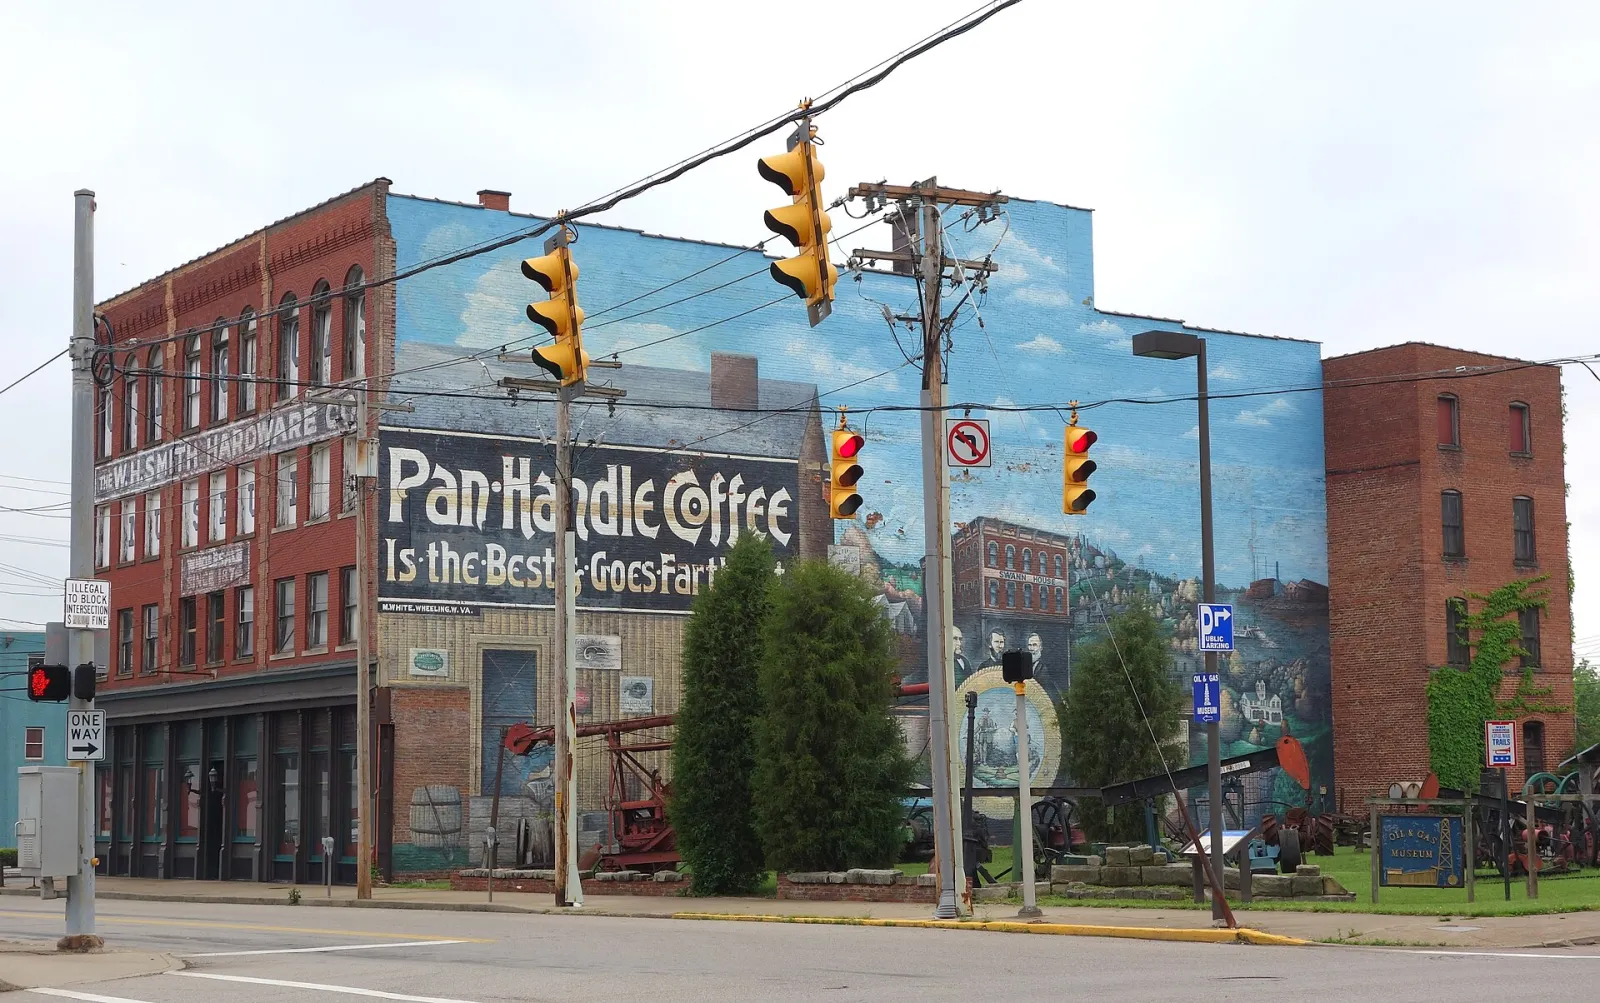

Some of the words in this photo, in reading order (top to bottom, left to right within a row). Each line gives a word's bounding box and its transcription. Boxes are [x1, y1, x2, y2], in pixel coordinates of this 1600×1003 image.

[206, 405, 317, 467] HARDWARE
[663, 468, 793, 547] Coffee
[999, 571, 1027, 581] SWANN
[1033, 576, 1056, 586] HOUSE
[71, 583, 104, 594] ILLEGAL
[68, 594, 77, 603] TO
[81, 594, 107, 604] BLOCK
[67, 604, 108, 615] INTERSECTION
[92, 615, 107, 626] FINE
[1209, 674, 1219, 682] GAS
[1197, 706, 1217, 715] MUSEUM
[72, 714, 100, 726] ONE
[71, 728, 101, 740] WAY
[1389, 829, 1405, 841] OIL
[1407, 828, 1414, 837] &
[1416, 830, 1438, 844] GAS
[1391, 849, 1433, 858] MUSEUM
